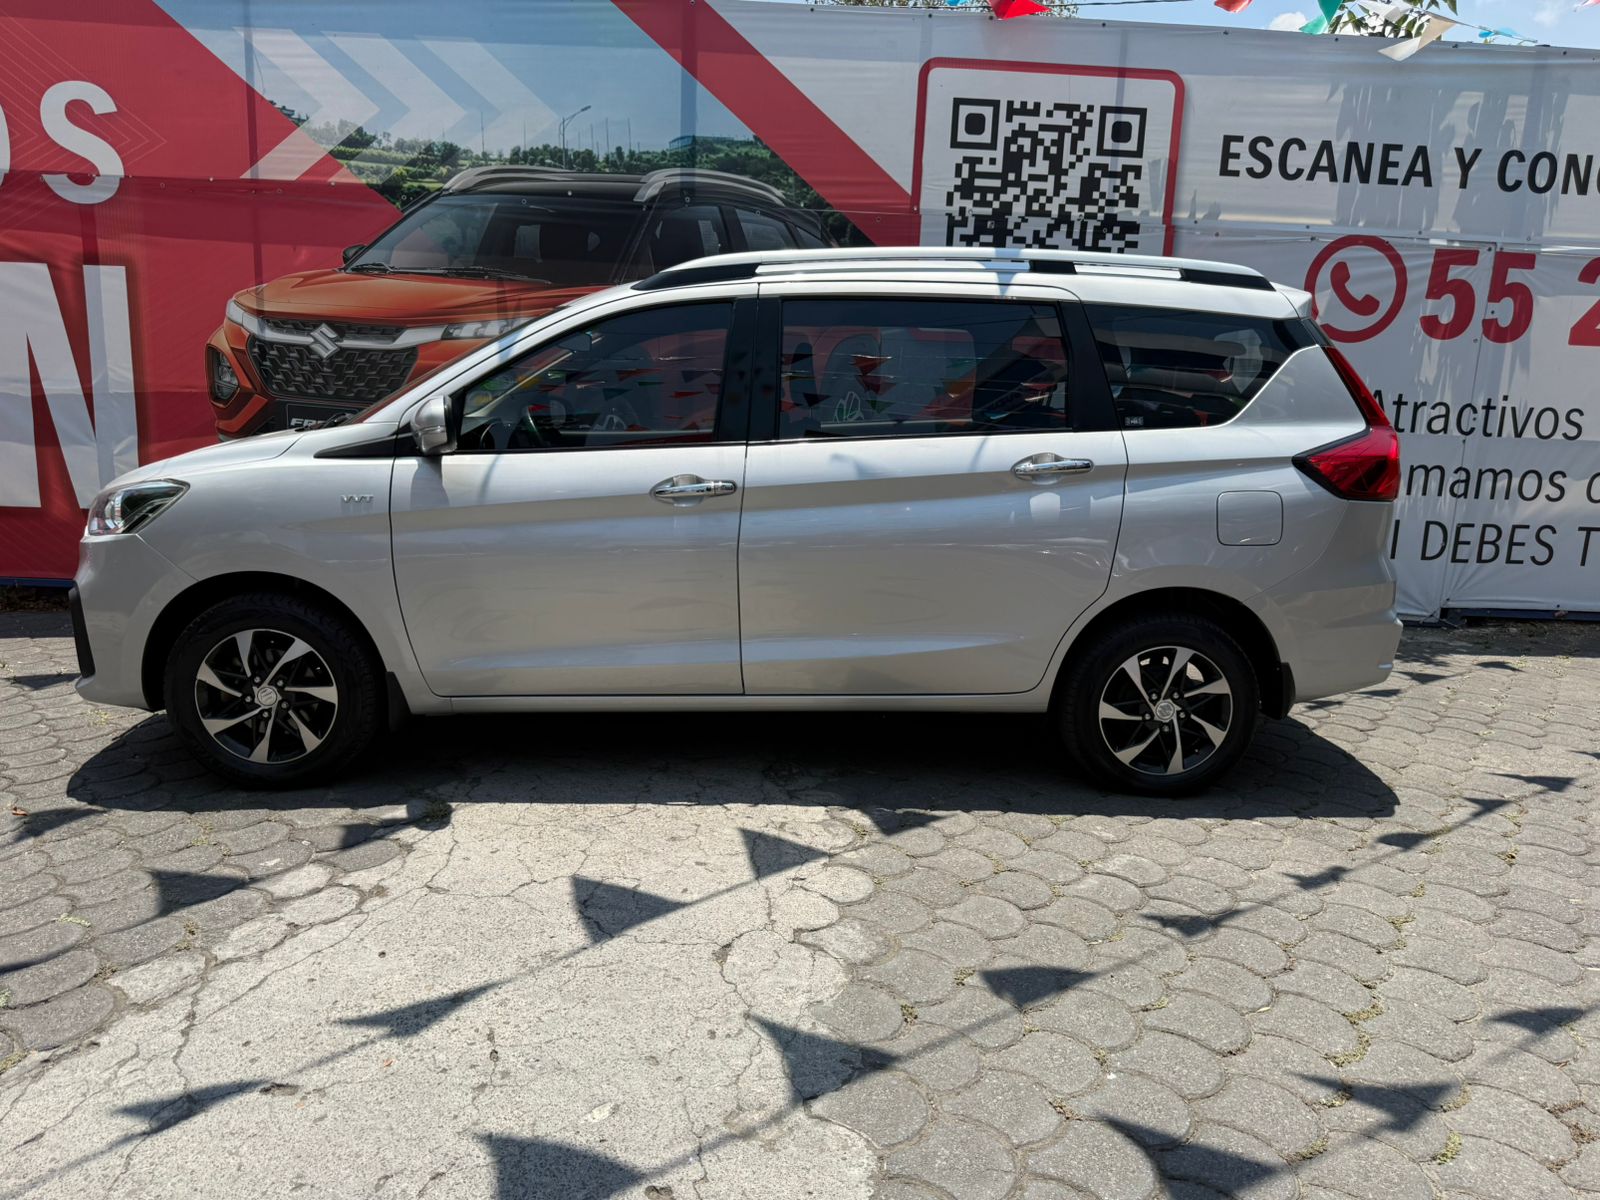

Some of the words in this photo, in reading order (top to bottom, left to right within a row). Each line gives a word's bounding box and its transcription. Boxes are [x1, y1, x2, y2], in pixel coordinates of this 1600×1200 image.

[0, 80, 124, 204] S
[1218, 134, 1433, 187] ESCANEA
[1454, 146, 1483, 189] Y
[1496, 149, 1600, 196] CON
[1419, 248, 1537, 344] 55
[1420, 520, 1558, 566] DEBES
